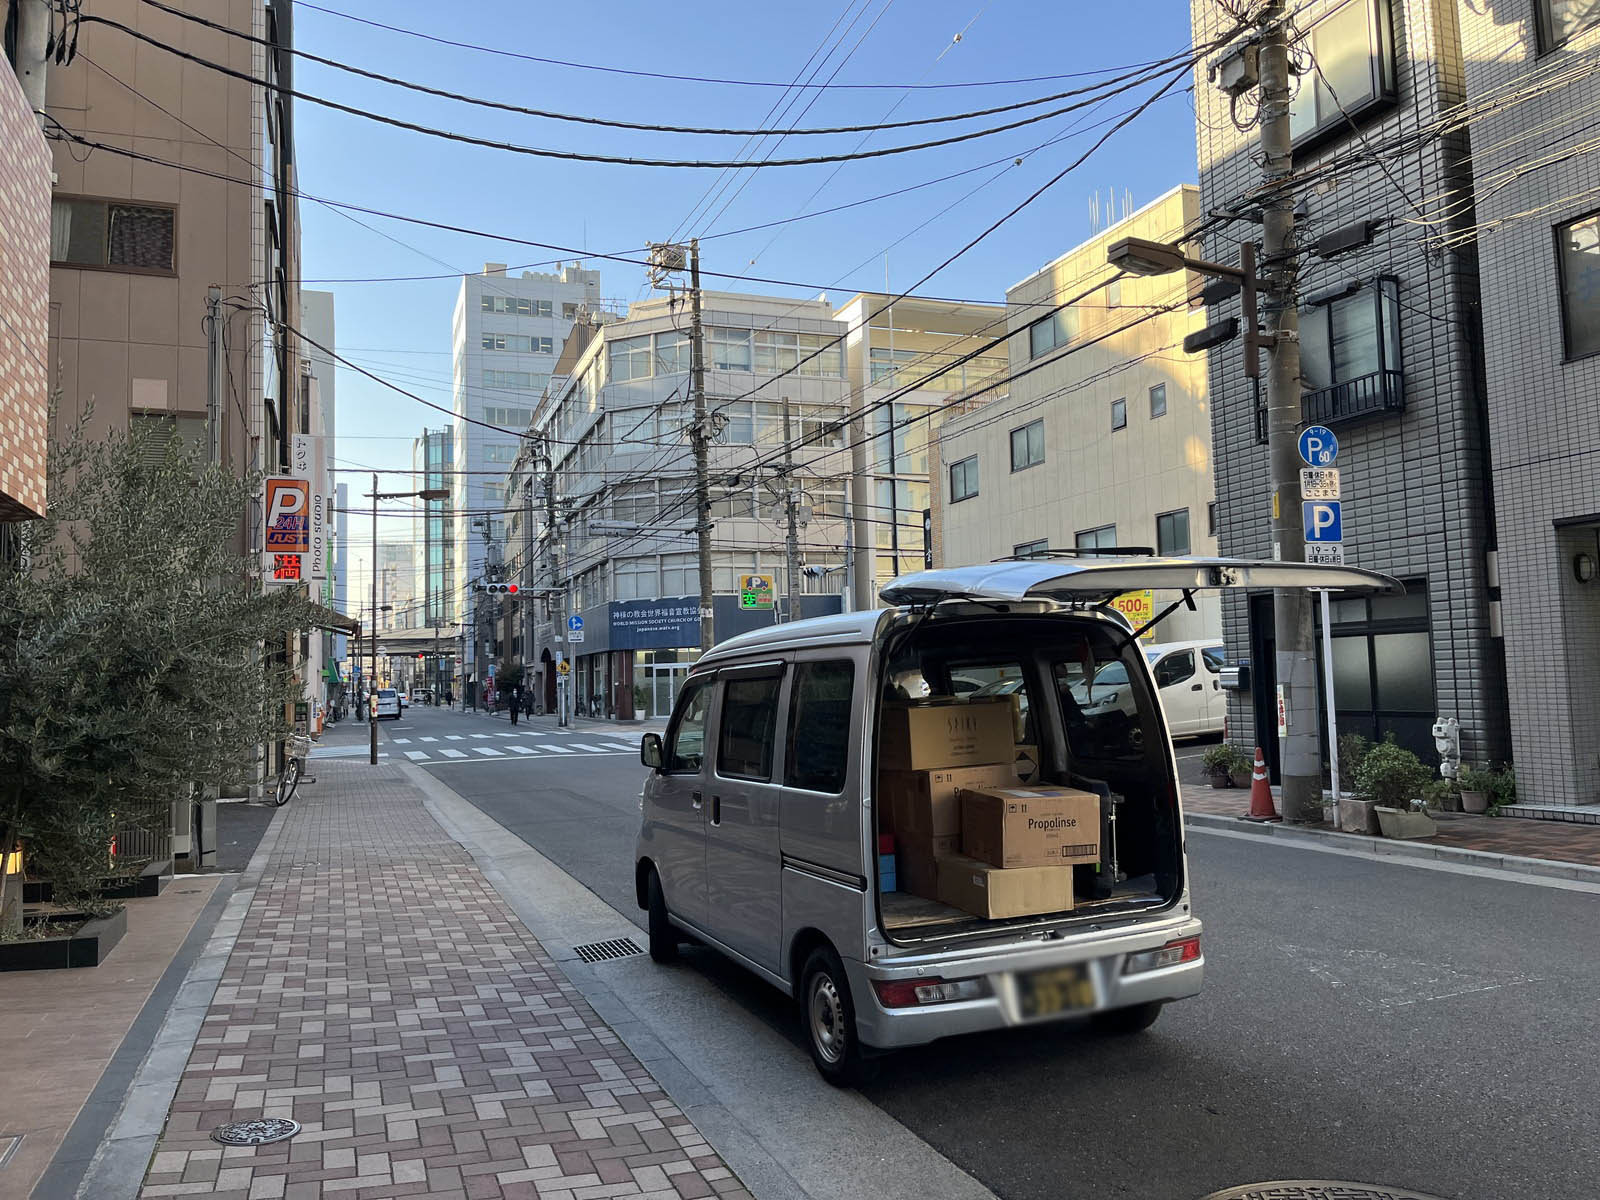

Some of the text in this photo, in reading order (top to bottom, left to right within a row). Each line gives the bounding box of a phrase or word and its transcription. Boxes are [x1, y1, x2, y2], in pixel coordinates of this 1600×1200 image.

[1307, 437, 1323, 462] P
[1305, 489, 1338, 497] ここまで
[267, 486, 305, 527] P
[273, 516, 305, 530] 24H
[1313, 505, 1335, 539] P
[269, 533, 307, 544] JUST
[312, 494, 322, 572] photo studio
[273, 554, 301, 580] 満
[751, 576, 762, 588] P
[1028, 815, 1077, 832] Propolinse
